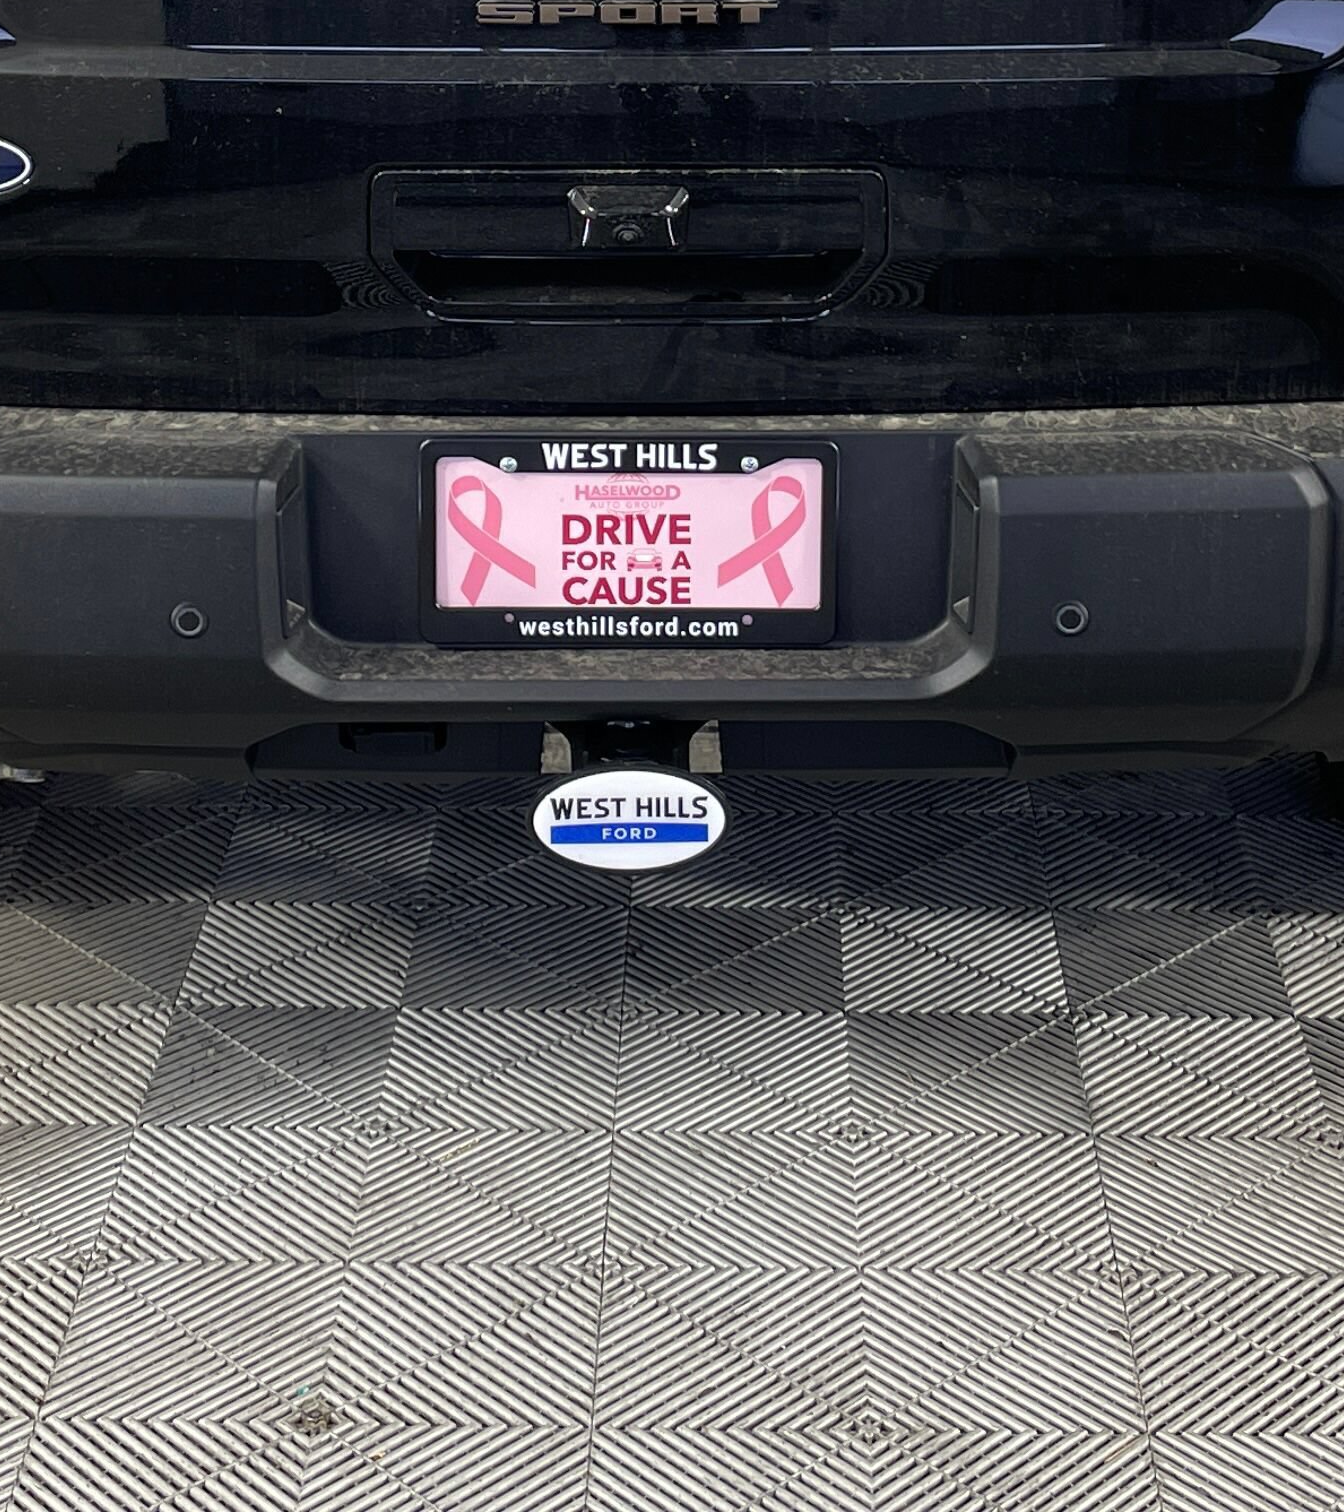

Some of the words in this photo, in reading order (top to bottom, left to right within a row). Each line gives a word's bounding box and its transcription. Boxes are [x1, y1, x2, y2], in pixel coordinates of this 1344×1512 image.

[541, 443, 627, 470] WEST
[636, 443, 719, 471] HILLS
[574, 484, 681, 501] HASELWOOD
[589, 501, 621, 509] AUTO
[625, 501, 665, 509] GROUP
[562, 514, 692, 545] DRIVE
[562, 551, 616, 571] FOR
[671, 551, 691, 570] A
[561, 576, 692, 606] CAUSE
[518, 615, 739, 638] westhillsford.com
[550, 797, 626, 820] WEST
[636, 796, 708, 819] HILLS
[602, 827, 657, 840] FORD
